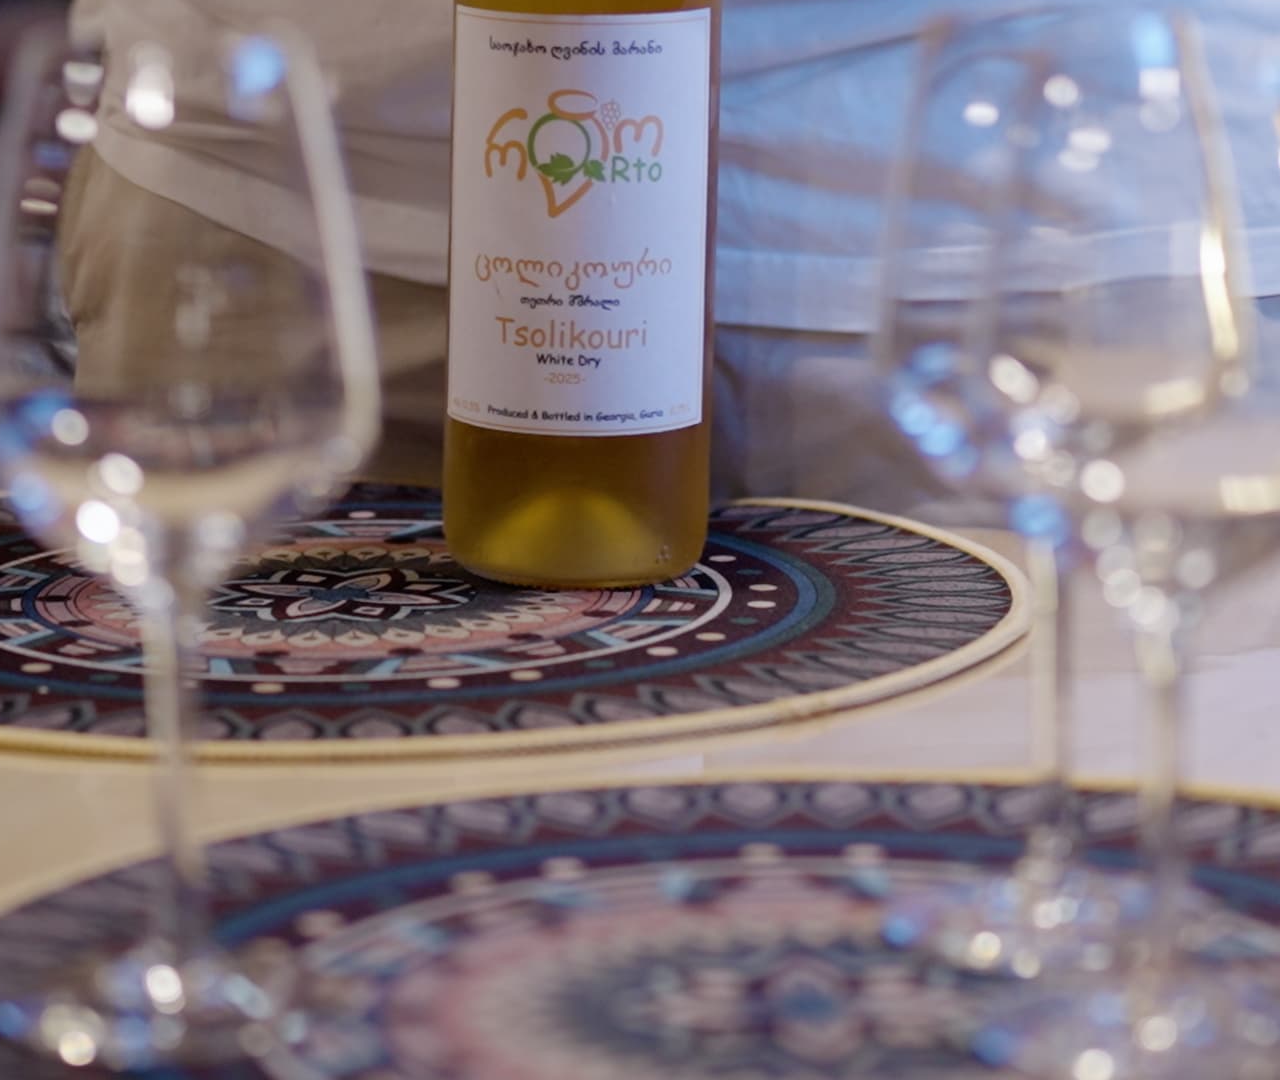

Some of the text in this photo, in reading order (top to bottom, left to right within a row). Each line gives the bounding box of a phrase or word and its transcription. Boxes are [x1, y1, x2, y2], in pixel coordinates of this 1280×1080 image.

[475, 247, 672, 291] ცოლიკოური
[495, 316, 648, 350] Tsolikouri
[536, 353, 601, 368] White Dry
[487, 404, 529, 420] Produced
[532, 408, 538, 420] &
[542, 410, 580, 422] Bottled
[584, 410, 593, 421] in
